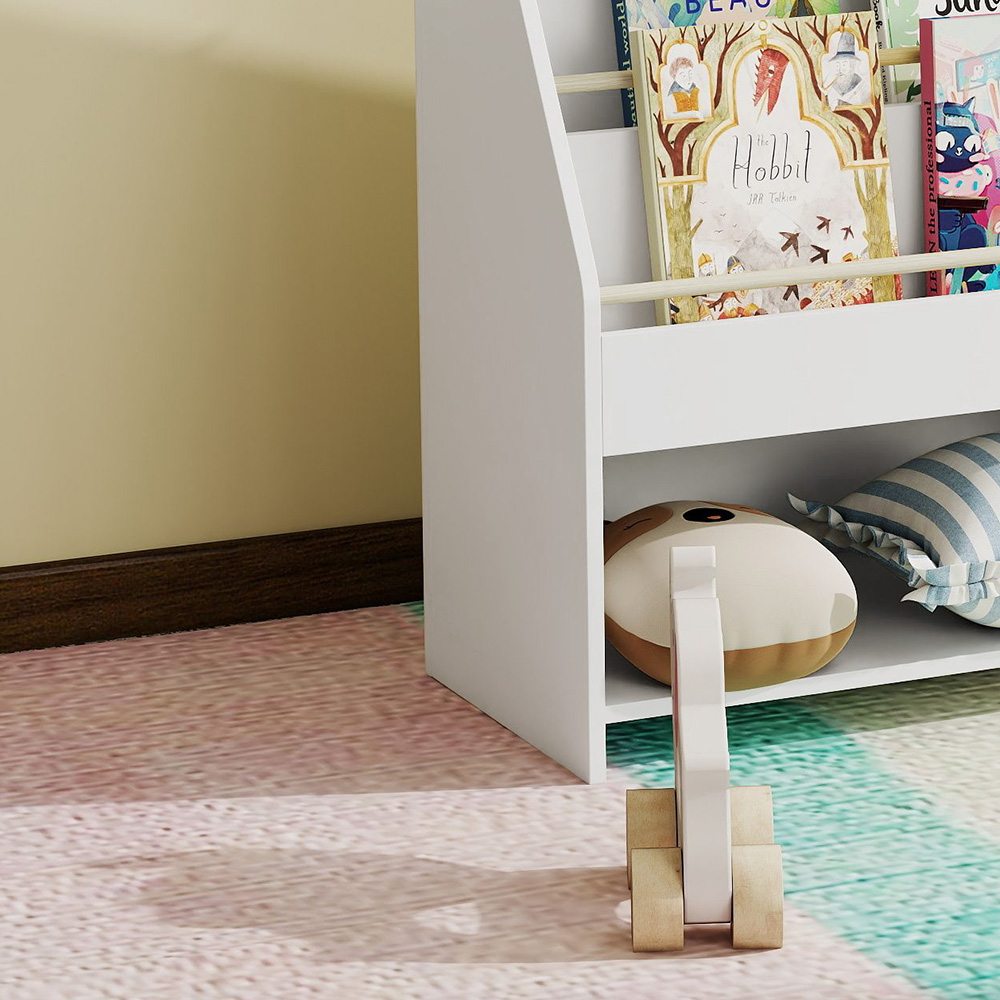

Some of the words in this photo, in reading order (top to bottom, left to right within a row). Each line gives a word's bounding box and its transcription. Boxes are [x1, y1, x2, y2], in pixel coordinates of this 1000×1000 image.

[616, 1, 629, 55] world
[733, 130, 811, 189] Hobbit
[757, 134, 768, 146] the
[924, 101, 937, 203] professional
[769, 191, 797, 203] Tolkien
[928, 208, 936, 234] the
[929, 241, 938, 293] LEN
